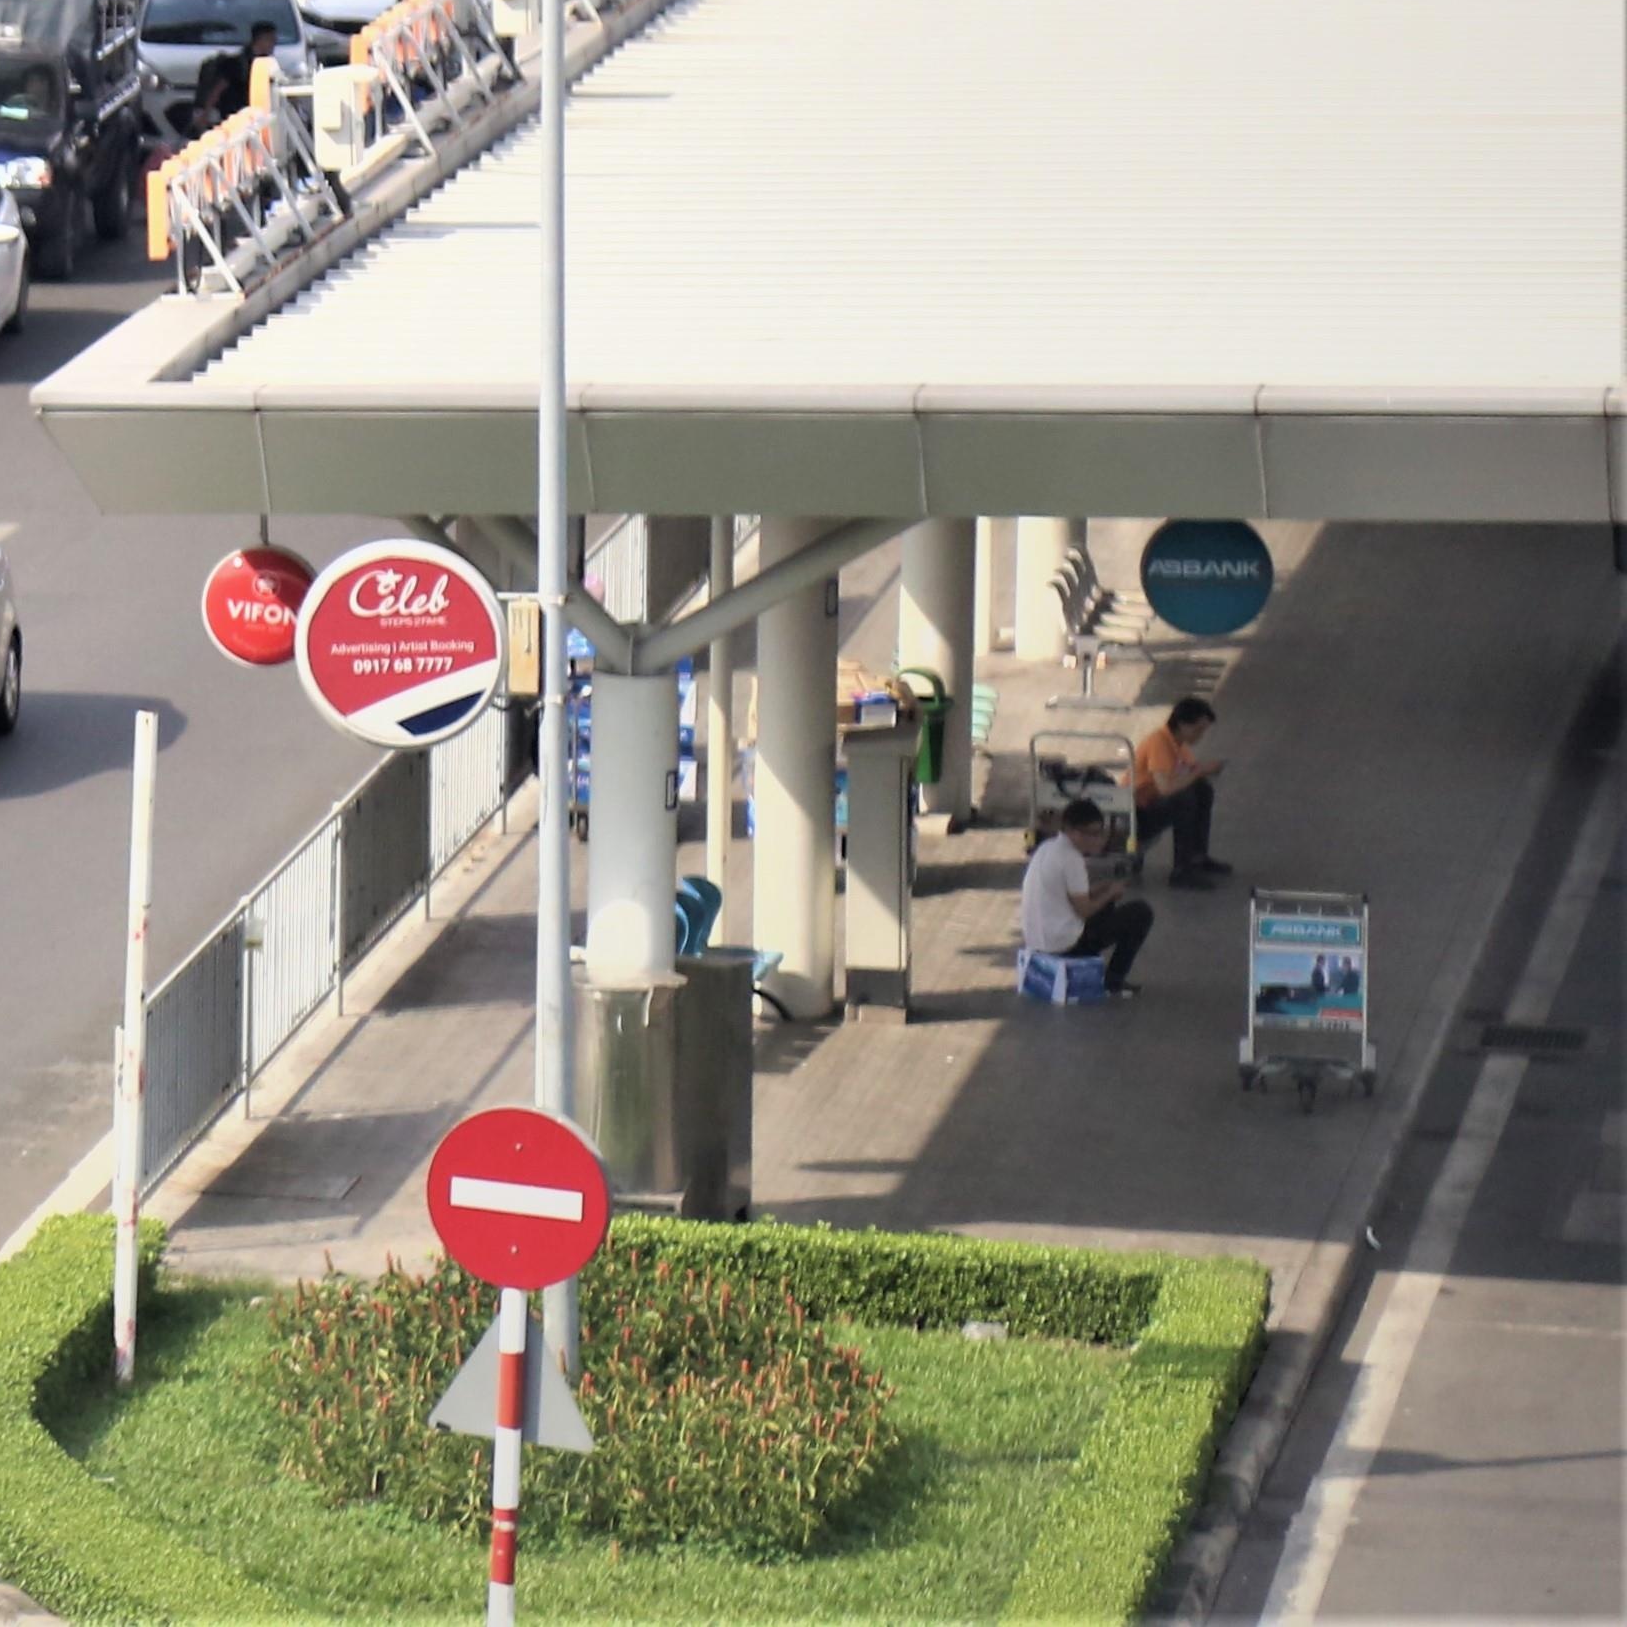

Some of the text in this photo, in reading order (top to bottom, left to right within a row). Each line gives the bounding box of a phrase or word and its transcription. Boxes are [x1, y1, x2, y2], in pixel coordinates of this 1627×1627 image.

[349, 568, 451, 618] Celeb
[331, 641, 391, 655] Advertising
[399, 640, 428, 653] Artist
[430, 639, 475, 654] Booking
[353, 658, 390, 675] 0917
[417, 656, 453, 672] 7777
